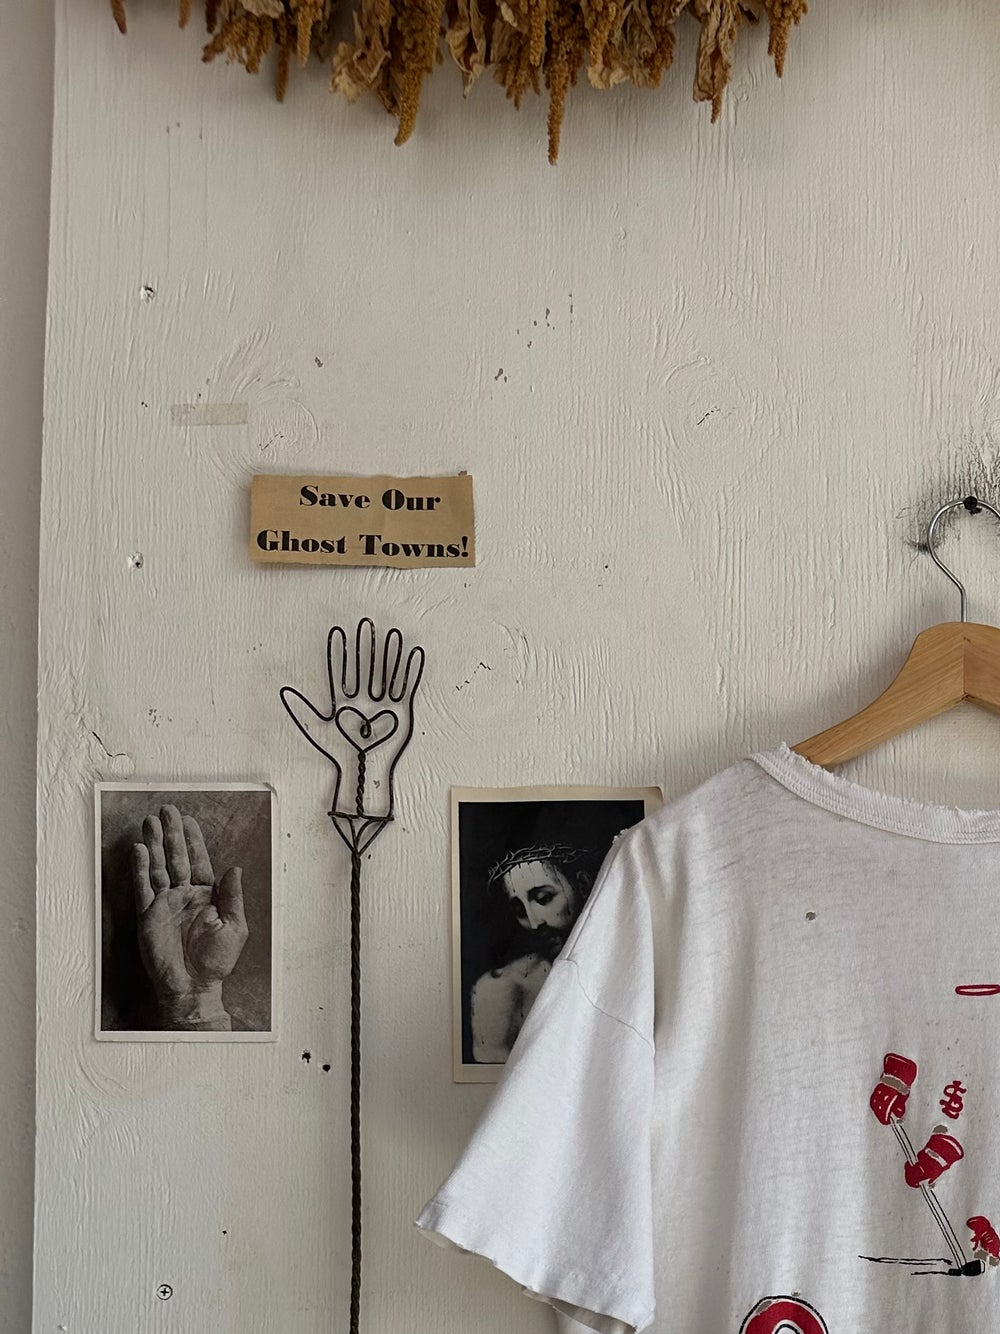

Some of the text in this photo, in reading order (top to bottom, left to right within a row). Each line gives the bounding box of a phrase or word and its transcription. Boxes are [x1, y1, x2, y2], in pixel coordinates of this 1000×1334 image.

[299, 485, 441, 511] Save Our
[256, 529, 469, 558] Ghost Towns!
